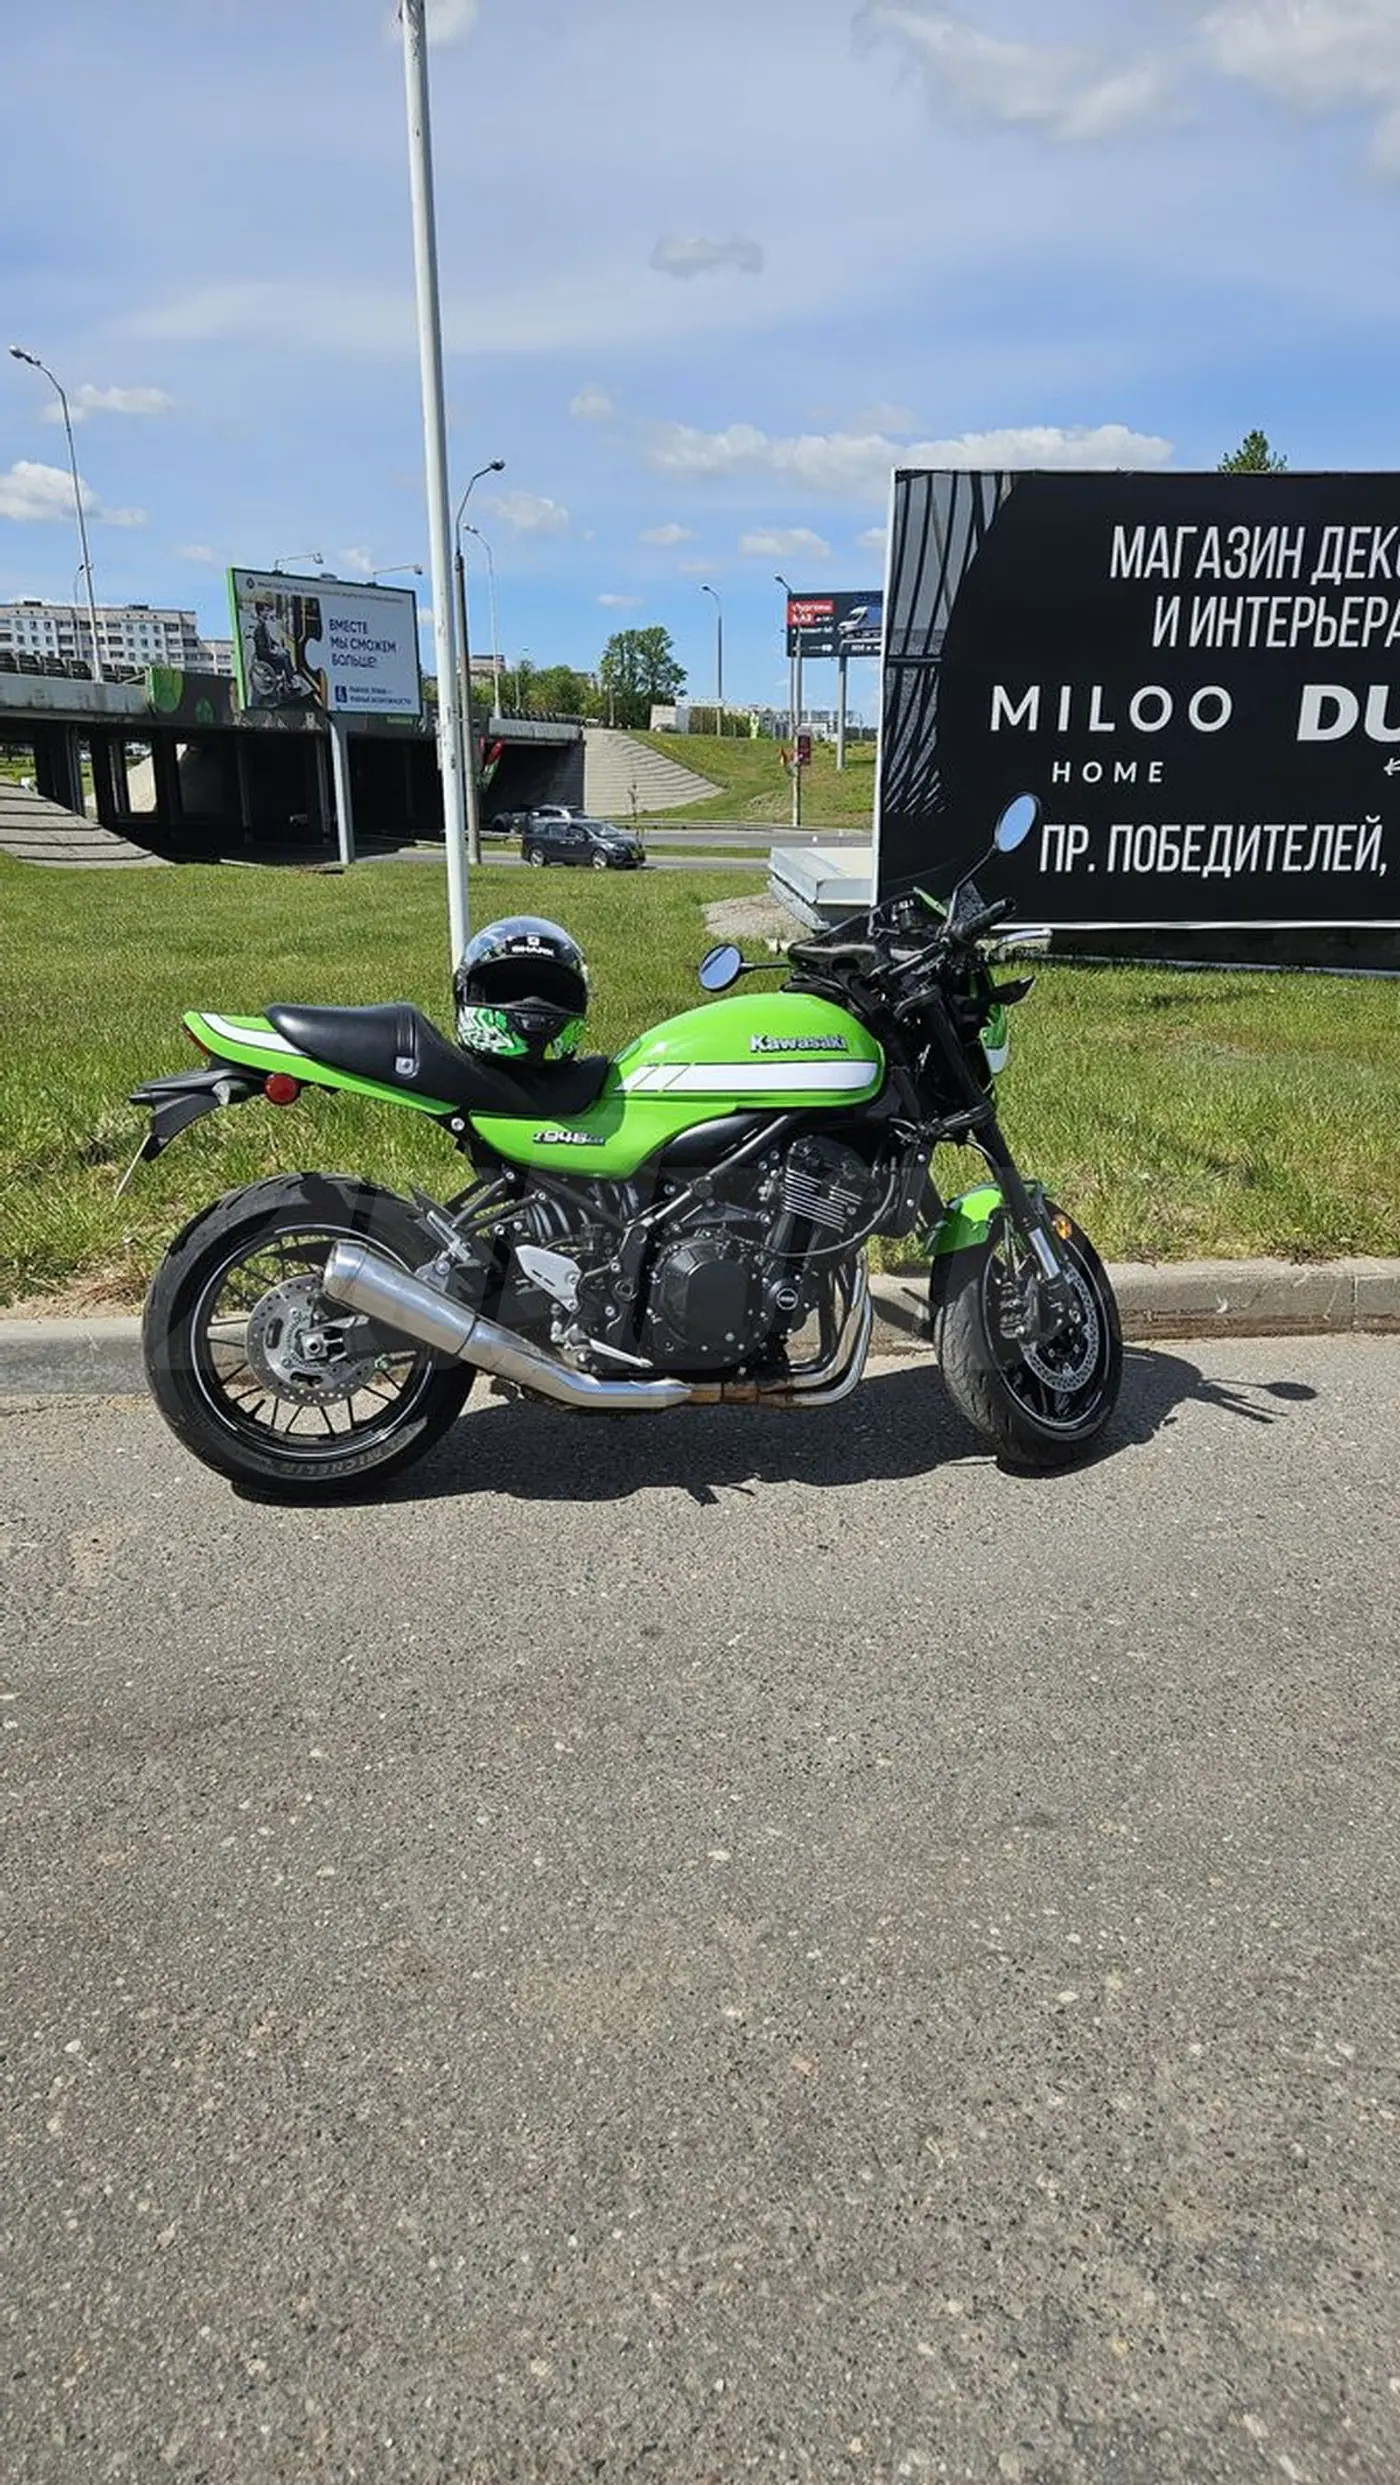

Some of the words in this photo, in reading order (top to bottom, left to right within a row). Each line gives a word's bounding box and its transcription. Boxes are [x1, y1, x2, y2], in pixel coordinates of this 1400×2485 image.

[1110, 525, 1305, 579] МАГАЗИН
[1310, 525, 1400, 586] ДЕК
[1152, 595, 1181, 648] И
[990, 684, 1233, 732] MILOO
[1052, 761, 1164, 783] HOME
[1039, 824, 1096, 873] ПР.
[1106, 815, 1387, 878] ПОБЕДИТЕЛЕЙ,
[750, 1032, 847, 1052] Kawasaki
